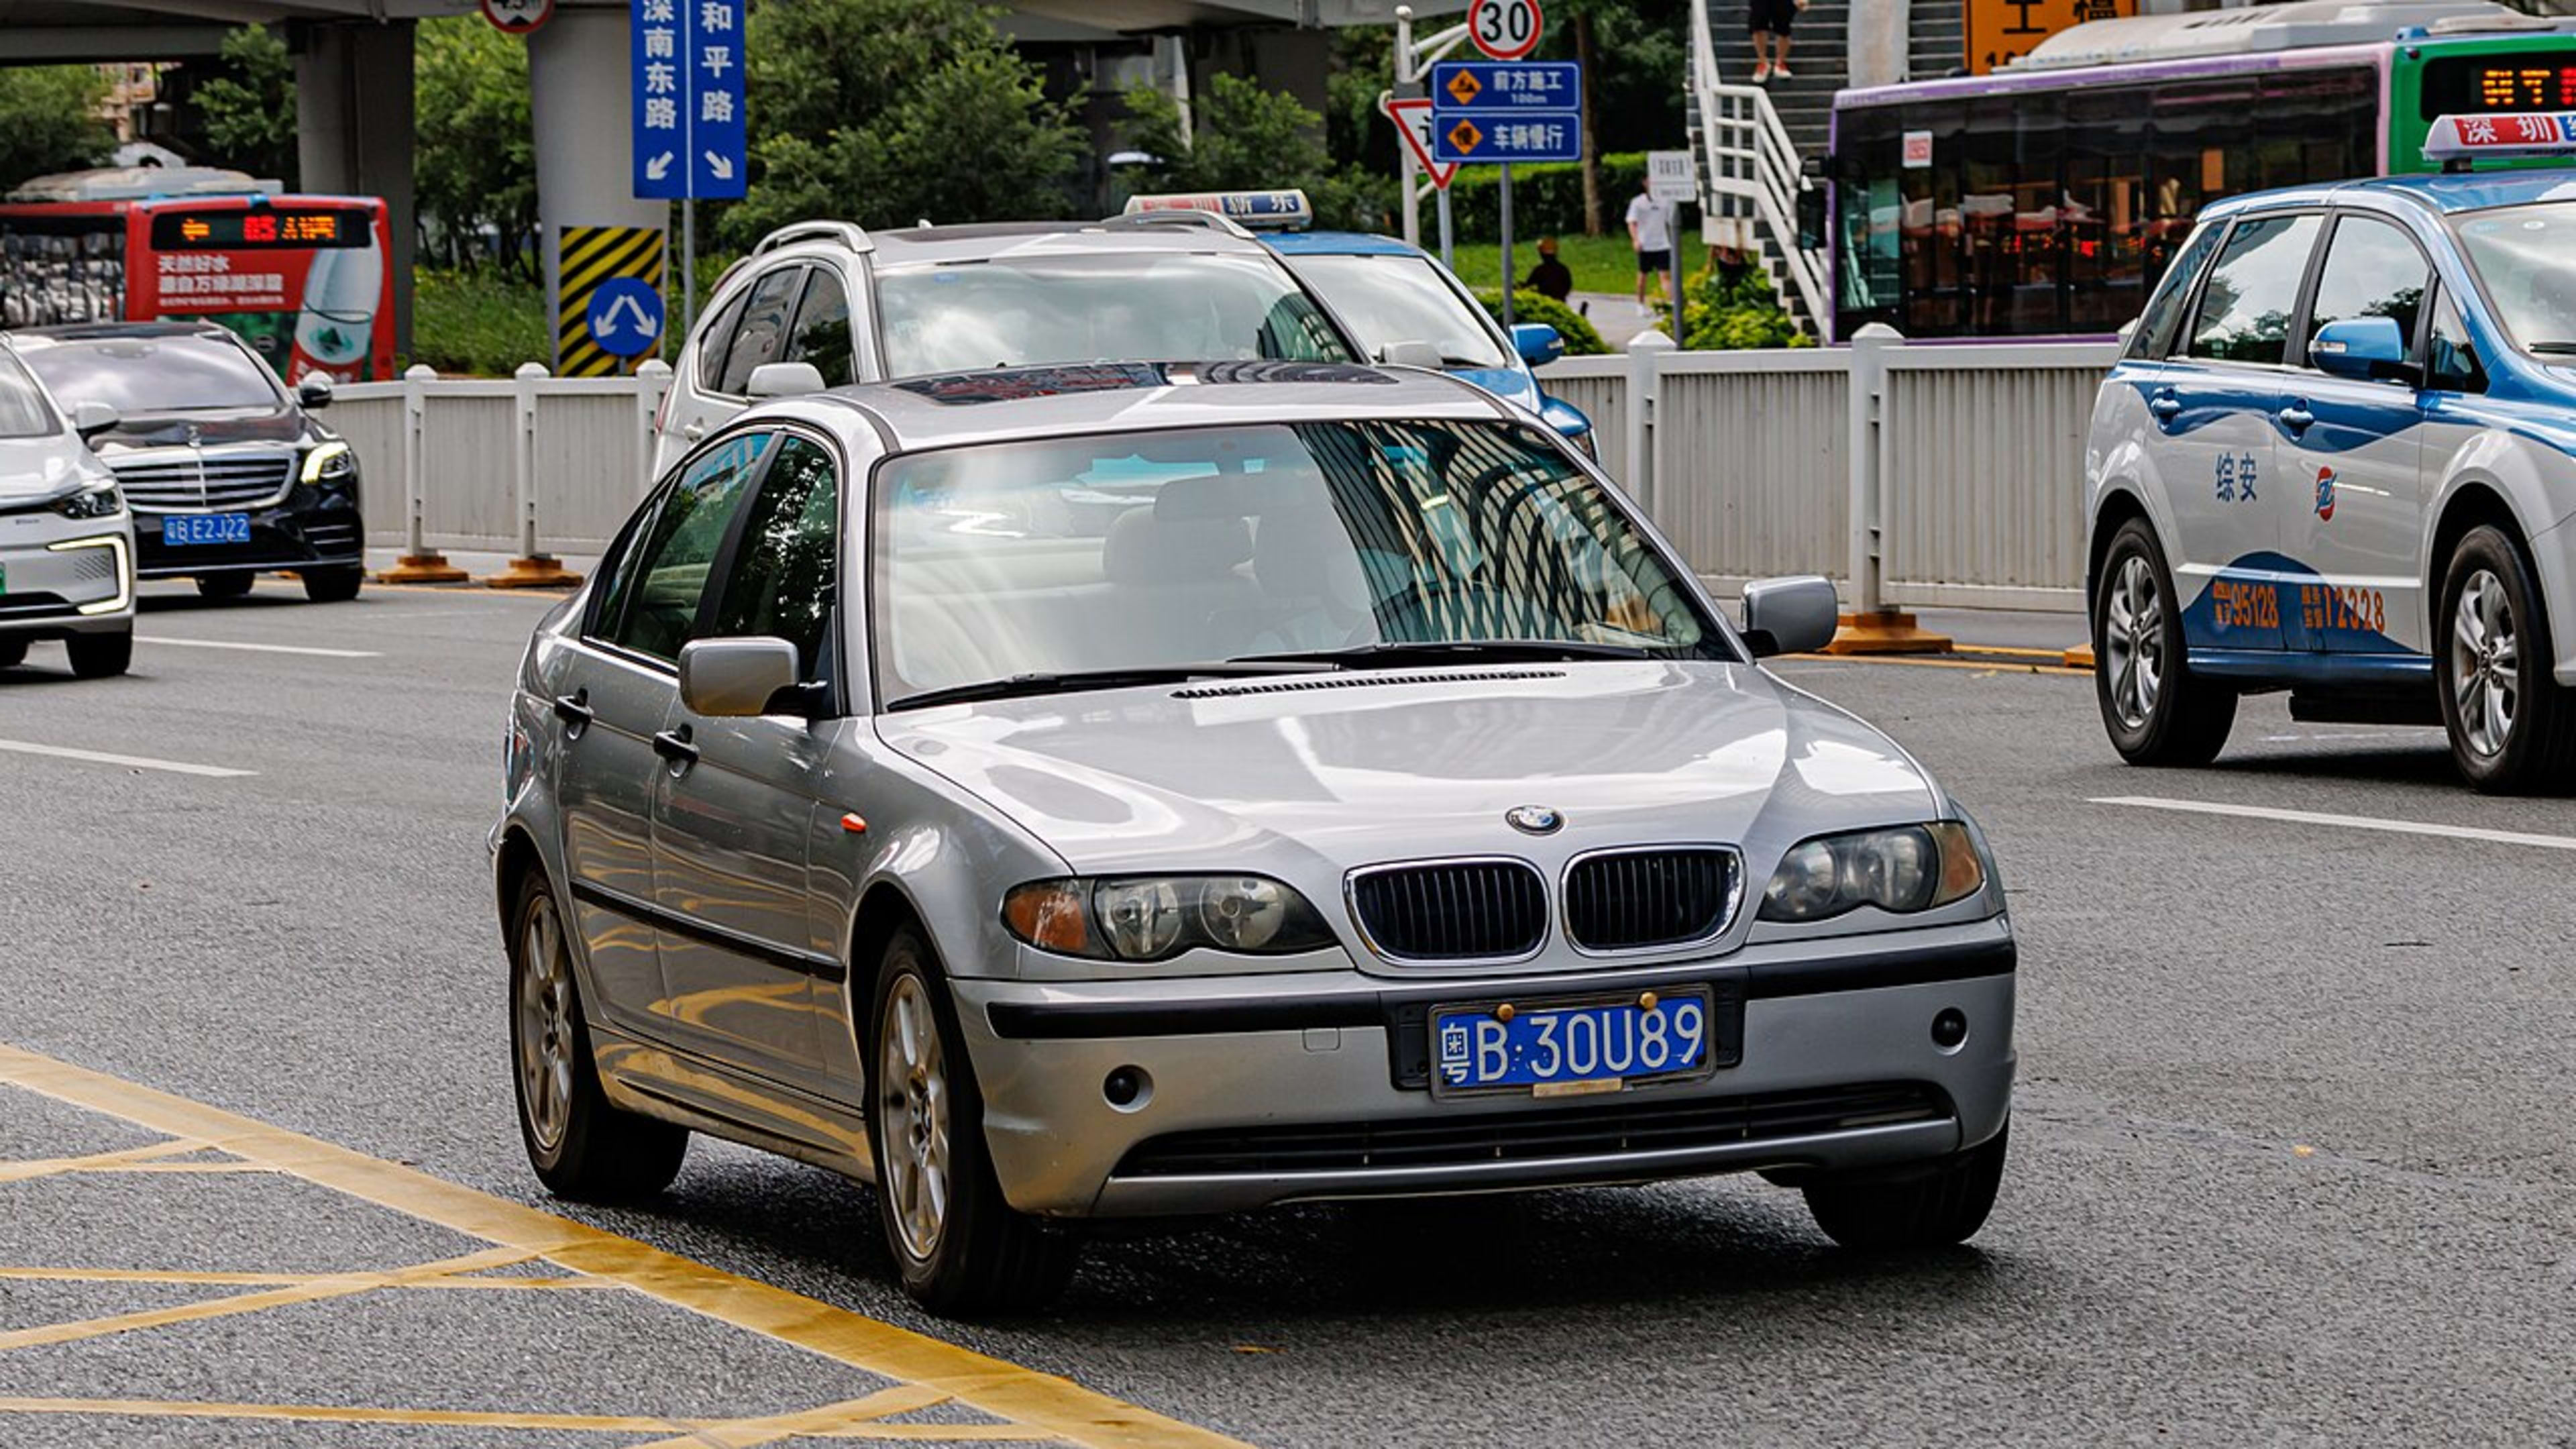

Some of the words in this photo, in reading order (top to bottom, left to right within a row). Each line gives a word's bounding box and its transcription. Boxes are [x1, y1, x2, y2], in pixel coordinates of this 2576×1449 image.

[1481, 2, 1529, 42] 30
[643, 0, 676, 129] 深南东路
[700, 2, 733, 123] 和平路
[1493, 70, 1563, 91] 前方施工
[1493, 123, 1564, 150] 车辆慢行
[2463, 116, 2553, 143] 深圳
[2216, 451, 2257, 502] 综安
[2231, 583, 2279, 628] 95128
[2323, 586, 2385, 634] 12328
